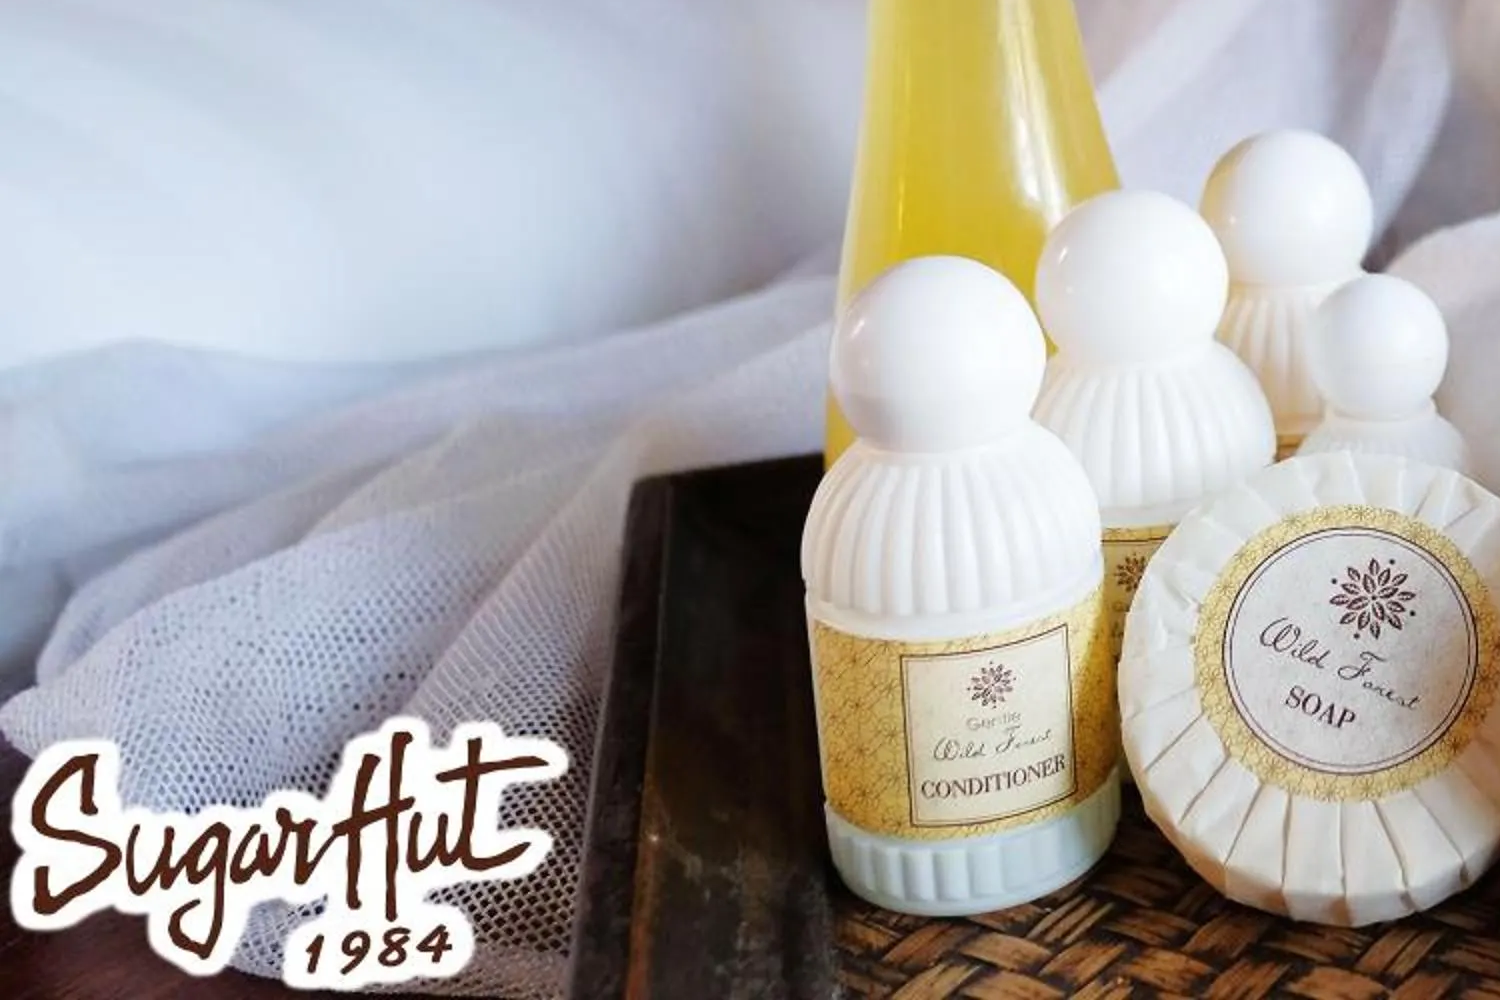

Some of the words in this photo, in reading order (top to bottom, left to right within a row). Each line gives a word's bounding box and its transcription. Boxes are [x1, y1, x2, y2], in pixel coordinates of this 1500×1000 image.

[1259, 616, 1333, 670] Wild
[1337, 650, 1421, 712] Forest
[1284, 685, 1356, 729] SOAP
[932, 736, 986, 761] Wild
[920, 752, 1066, 800] CONDITIONER
